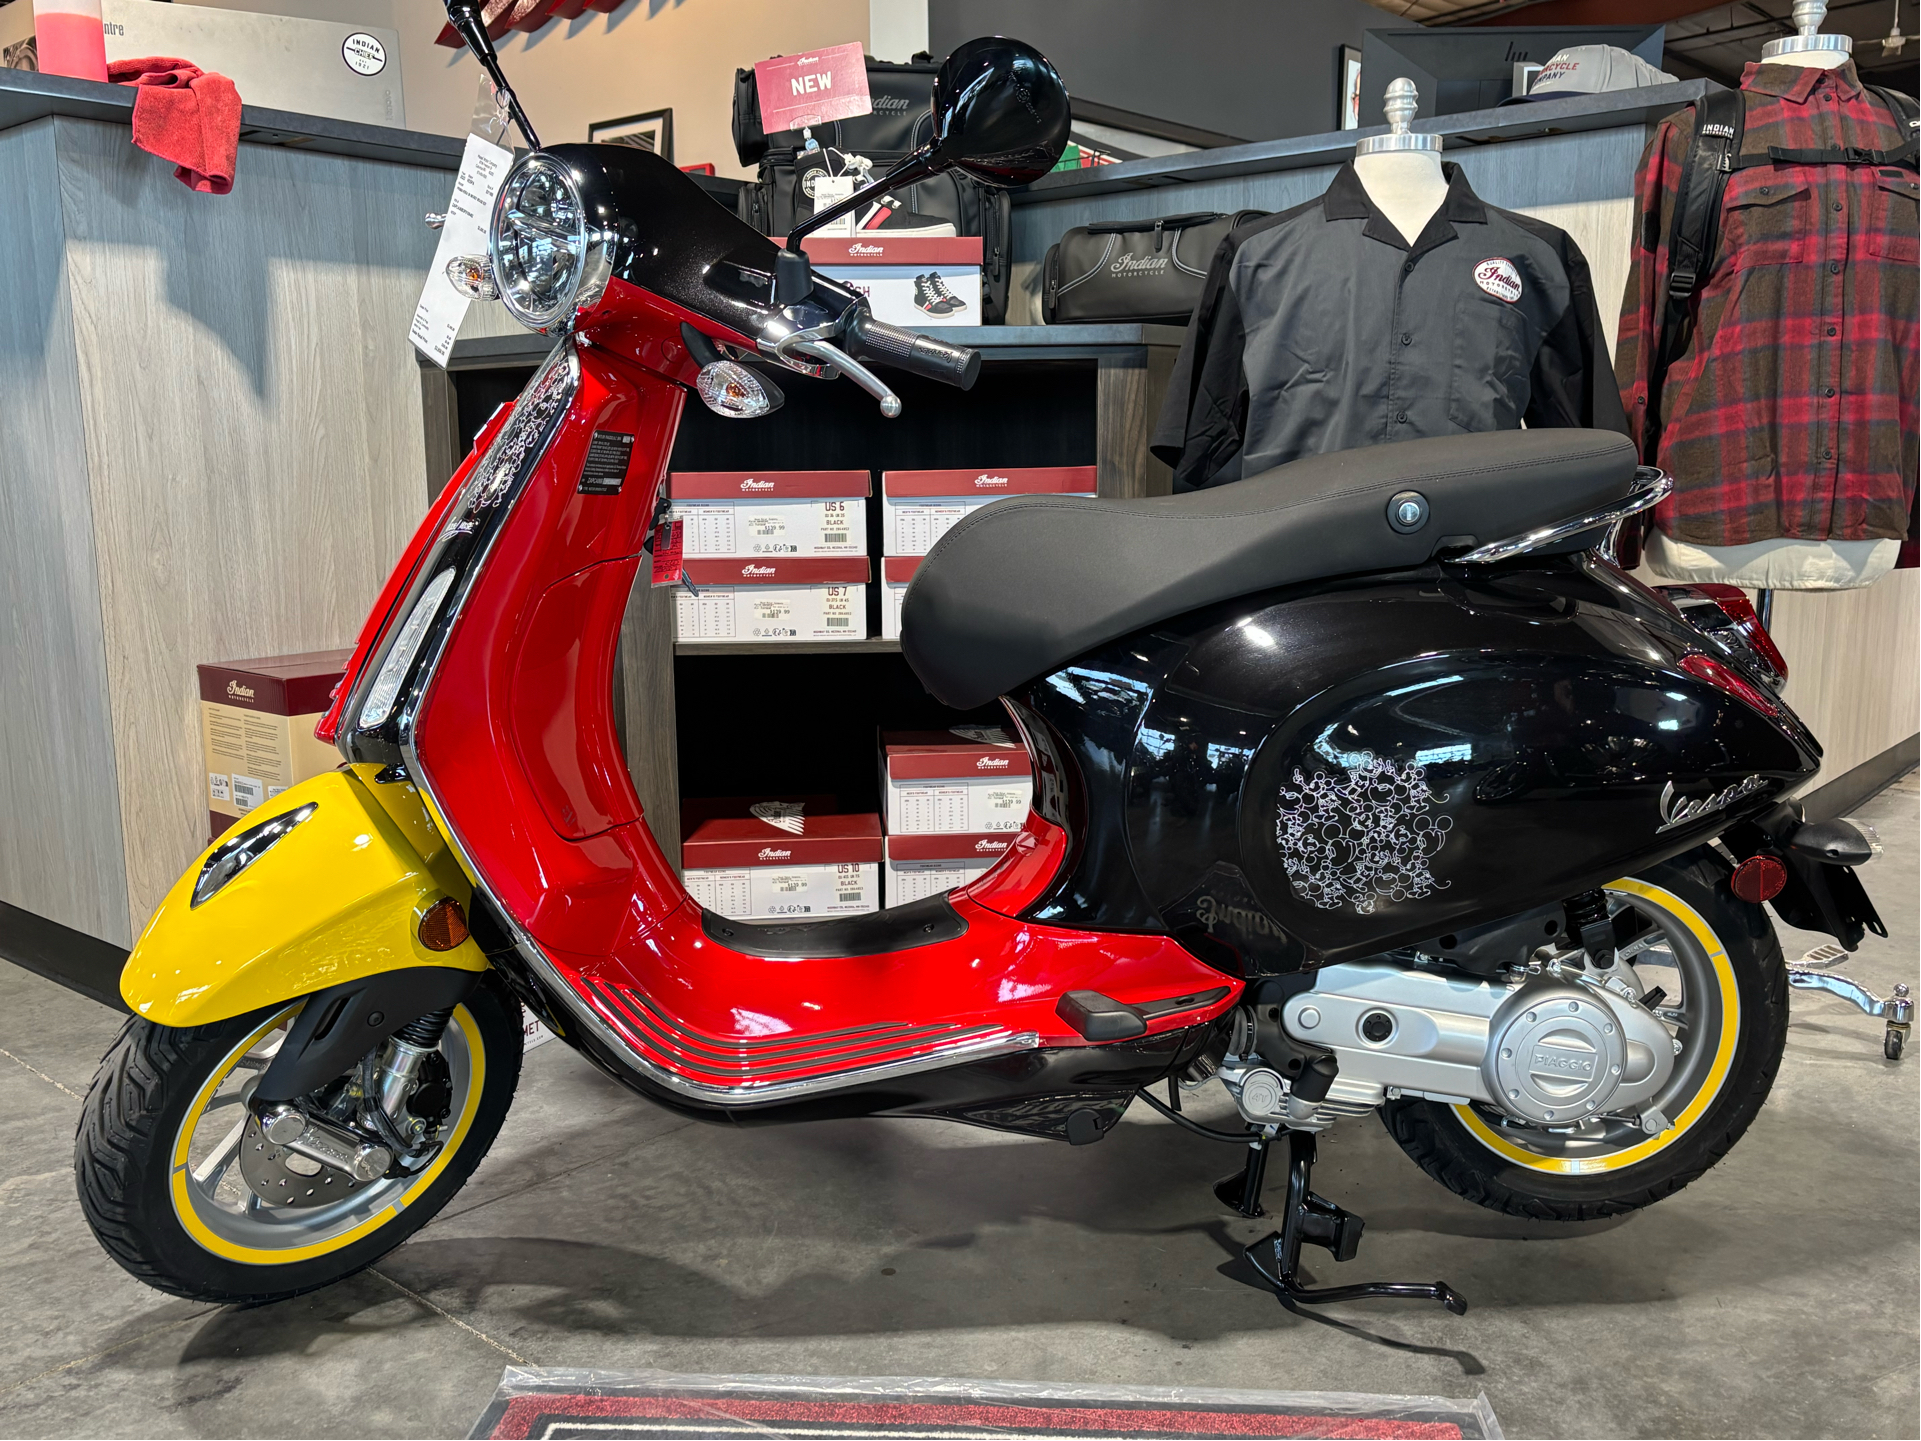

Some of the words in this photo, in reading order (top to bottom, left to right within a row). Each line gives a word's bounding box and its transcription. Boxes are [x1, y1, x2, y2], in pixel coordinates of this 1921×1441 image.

[352, 38, 381, 54] INDIAN
[355, 61, 370, 70] 1921
[790, 70, 832, 96] NEW
[1702, 124, 1735, 136] INDIAN
[848, 243, 884, 254] Indian
[1110, 252, 1168, 272] Indian
[1111, 270, 1165, 278] MOTORCYCLE
[1477, 266, 1521, 292] Indian
[741, 478, 775, 489] Indian
[974, 474, 1008, 484] Indian
[825, 501, 836, 512] US
[840, 501, 845, 512] 6
[742, 564, 776, 574] Indian
[828, 586, 839, 596] US
[842, 586, 848, 596] 7
[227, 680, 254, 698] Indian
[977, 756, 1009, 766] Indian
[1655, 774, 1769, 834] Vespa
[975, 840, 1007, 849] Indian
[758, 848, 791, 857] Indian
[838, 864, 849, 874] US
[851, 863, 860, 873] 10
[1535, 1053, 1592, 1072] PIAGGIO
